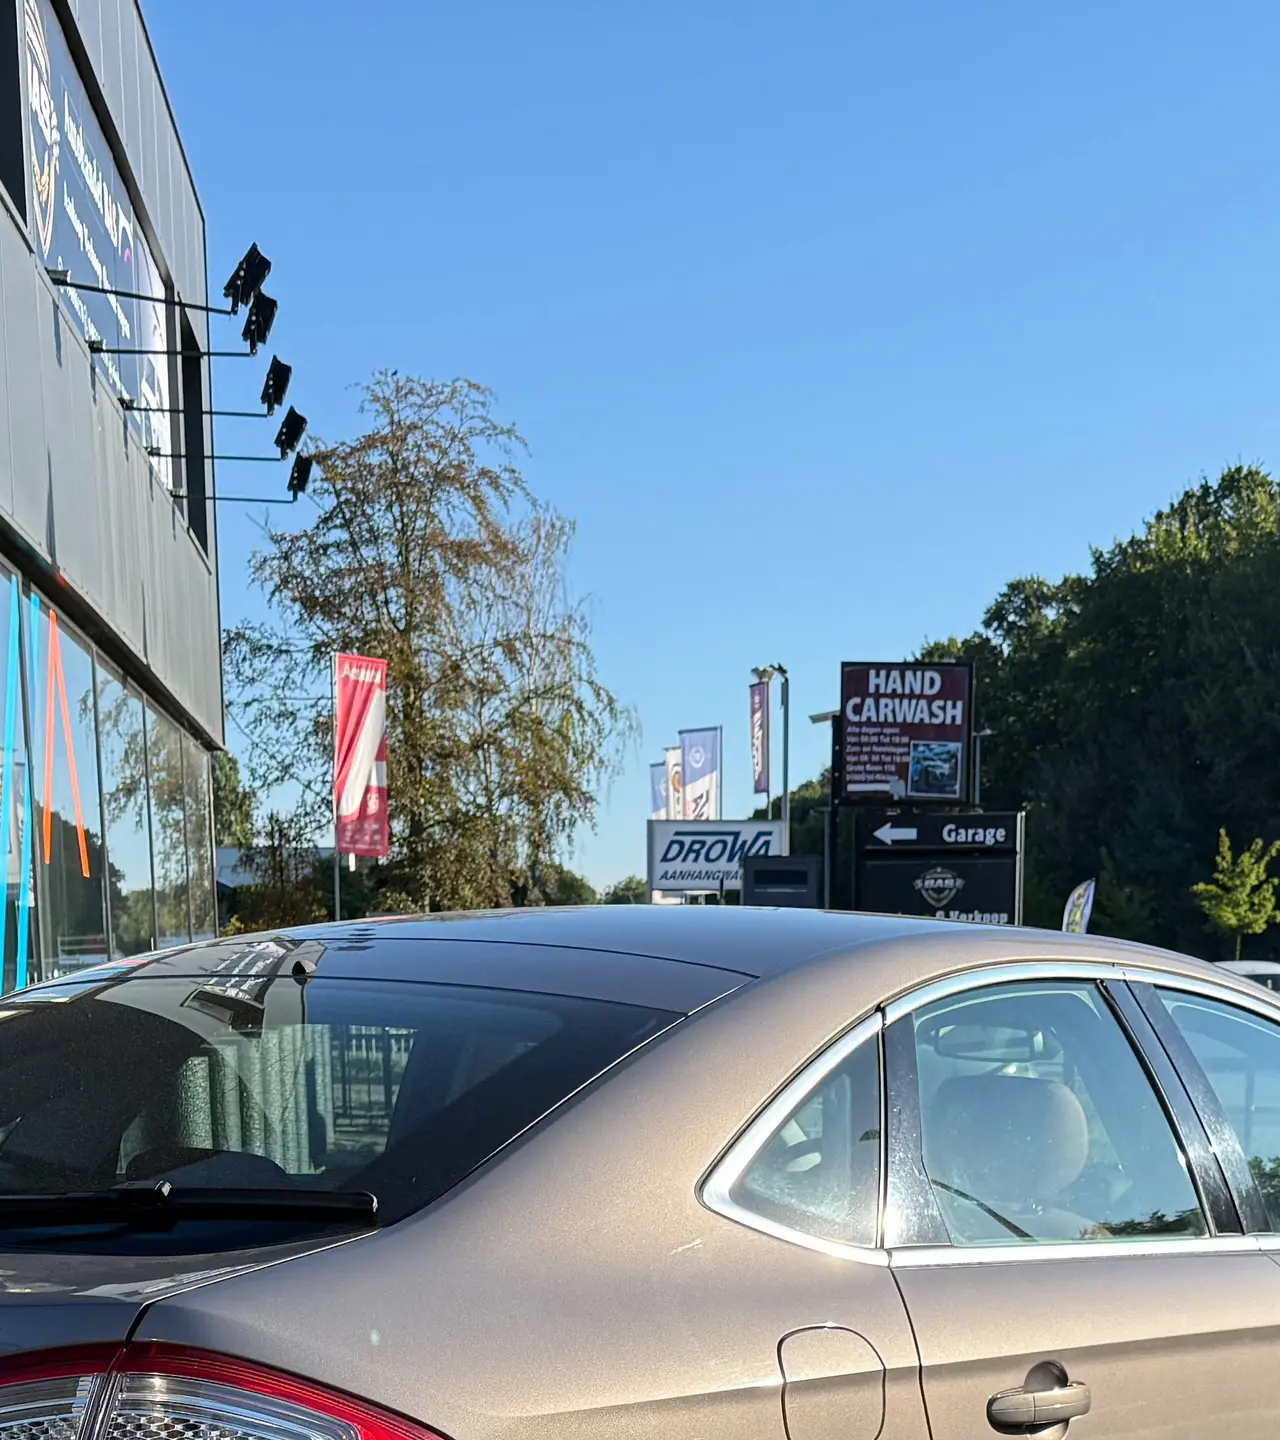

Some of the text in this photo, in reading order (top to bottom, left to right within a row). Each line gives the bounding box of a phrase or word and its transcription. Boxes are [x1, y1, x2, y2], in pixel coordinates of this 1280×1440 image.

[868, 669, 942, 695] HAND
[845, 696, 963, 725] CARWASH
[660, 831, 773, 864] DROWA
[942, 824, 1006, 845] Garage
[659, 870, 743, 882] AANHANGWA
